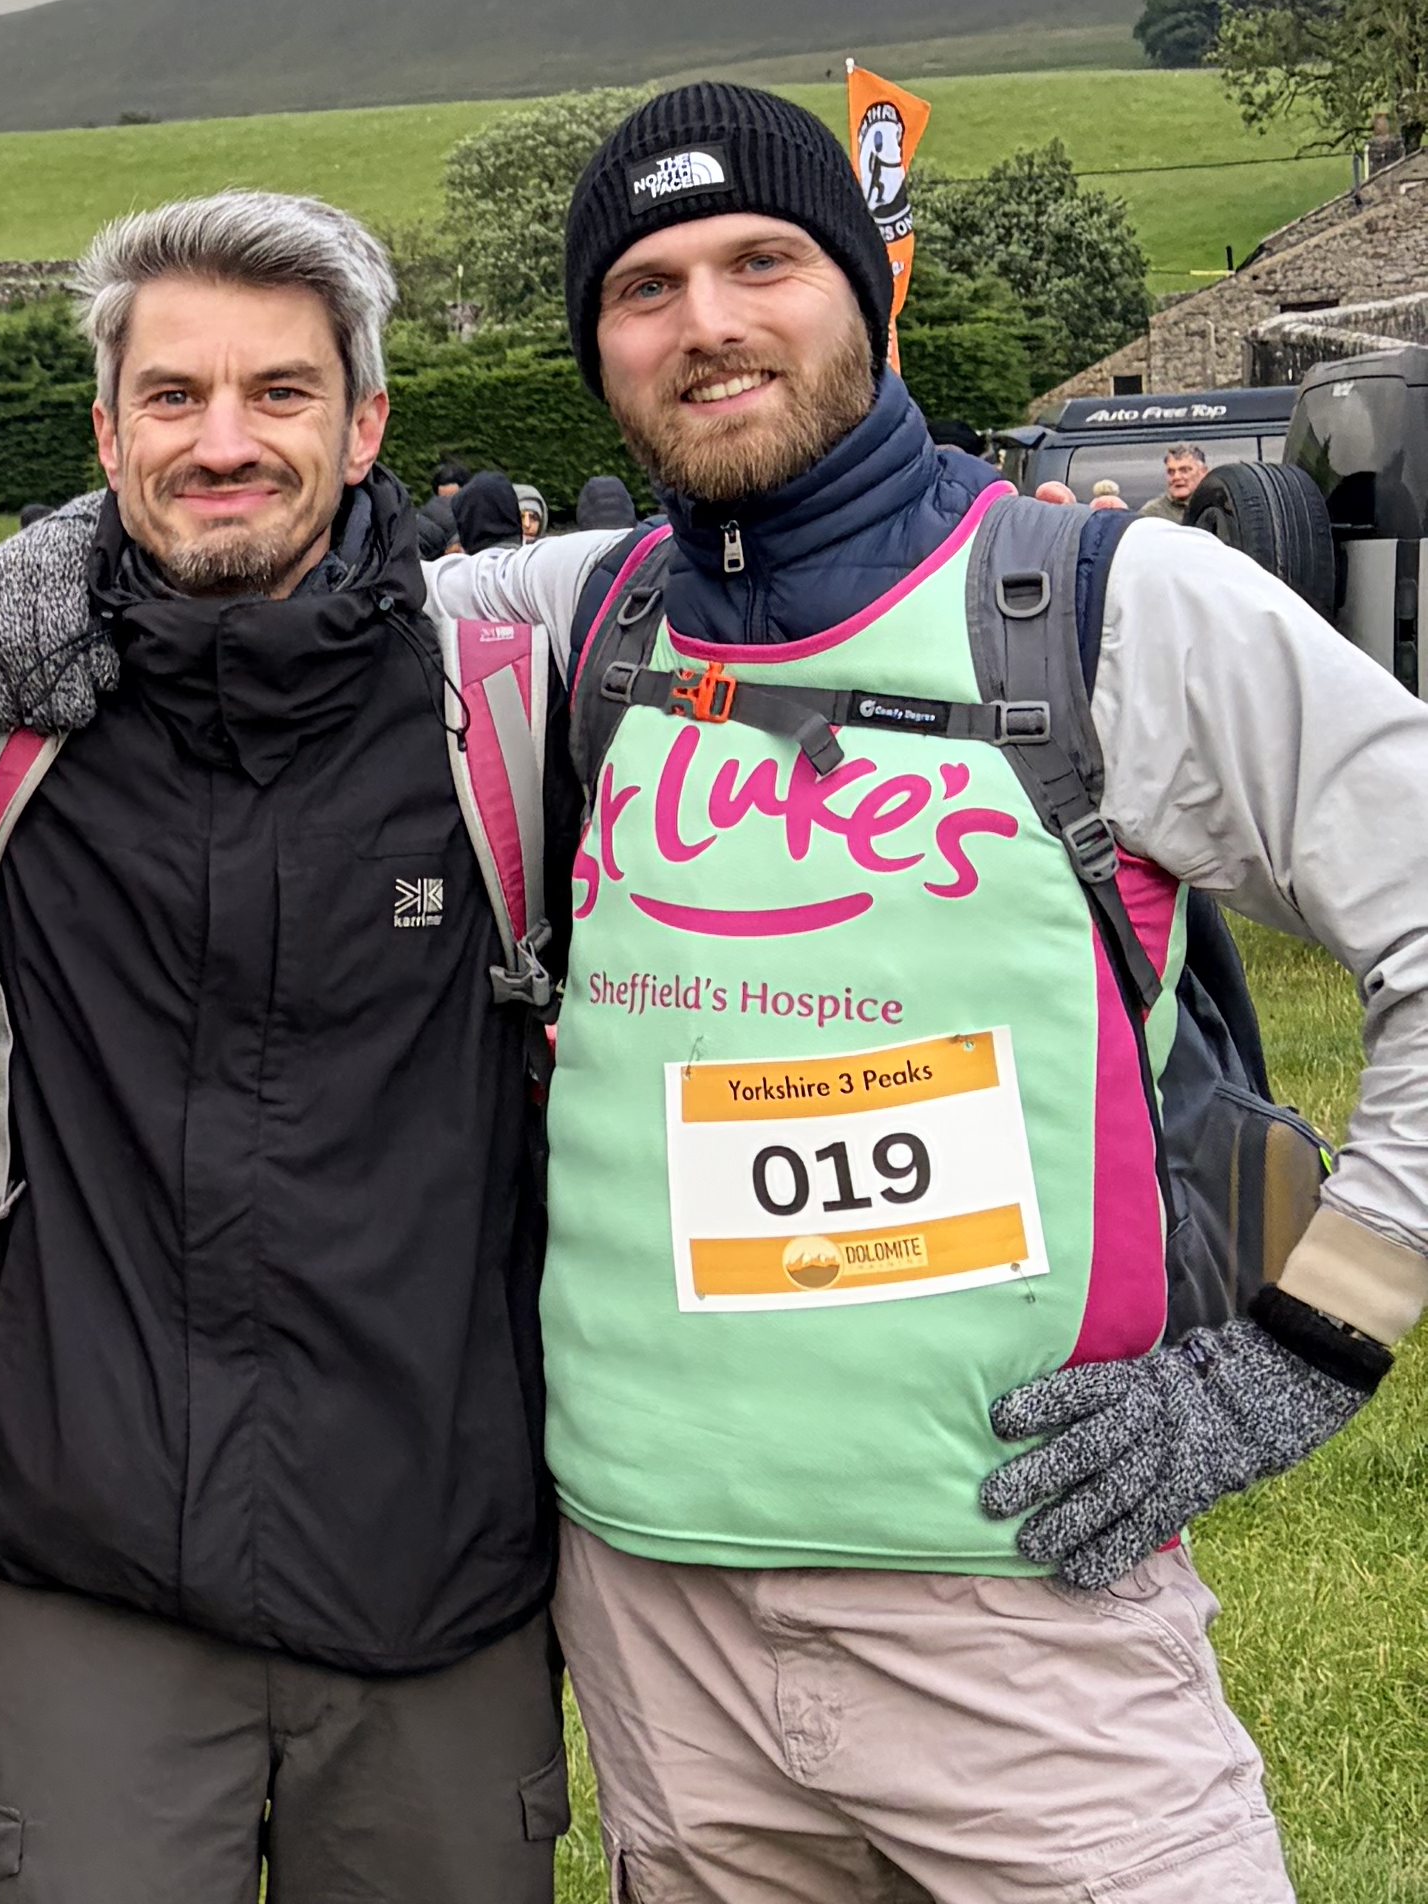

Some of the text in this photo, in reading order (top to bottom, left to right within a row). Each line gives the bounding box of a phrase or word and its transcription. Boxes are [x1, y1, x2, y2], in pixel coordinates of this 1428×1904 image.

[656, 152, 690, 171] THE
[633, 163, 692, 195] NORTH
[650, 178, 694, 198] FACE
[1085, 404, 1227, 423] Auto Free Top
[654, 725, 1019, 899] Luke's
[589, 971, 904, 1028] Sheffield's Hospice
[728, 1059, 934, 1102] Yorkshire 3 Peaks
[752, 1132, 932, 1216] 019
[845, 1237, 922, 1265] DOLOMITE
